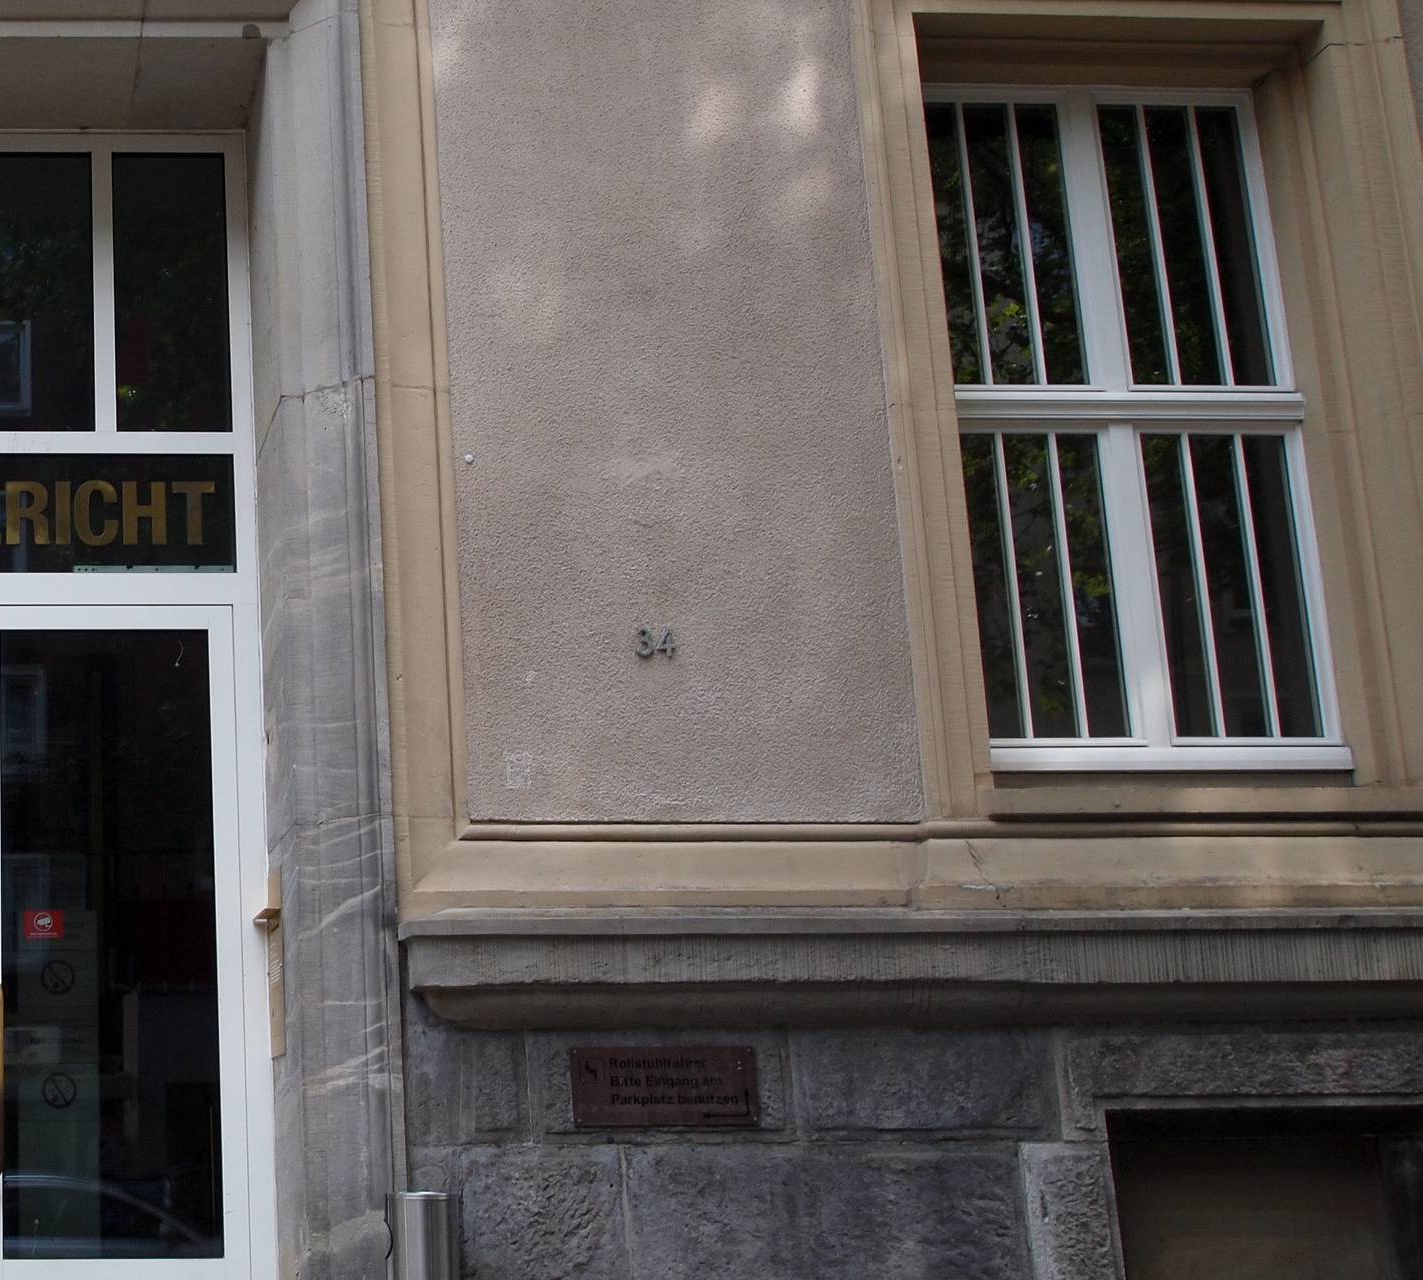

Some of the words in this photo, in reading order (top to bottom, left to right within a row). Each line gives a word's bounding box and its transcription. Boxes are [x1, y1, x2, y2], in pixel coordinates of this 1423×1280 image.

[635, 626, 676, 659] 34
[609, 1057, 705, 1070] Rollstuhlfahrer
[646, 1075, 699, 1089] Eingang
[702, 1077, 722, 1087] am
[611, 1093, 674, 1106] Parkplatz
[678, 1094, 738, 1105] benutzen
